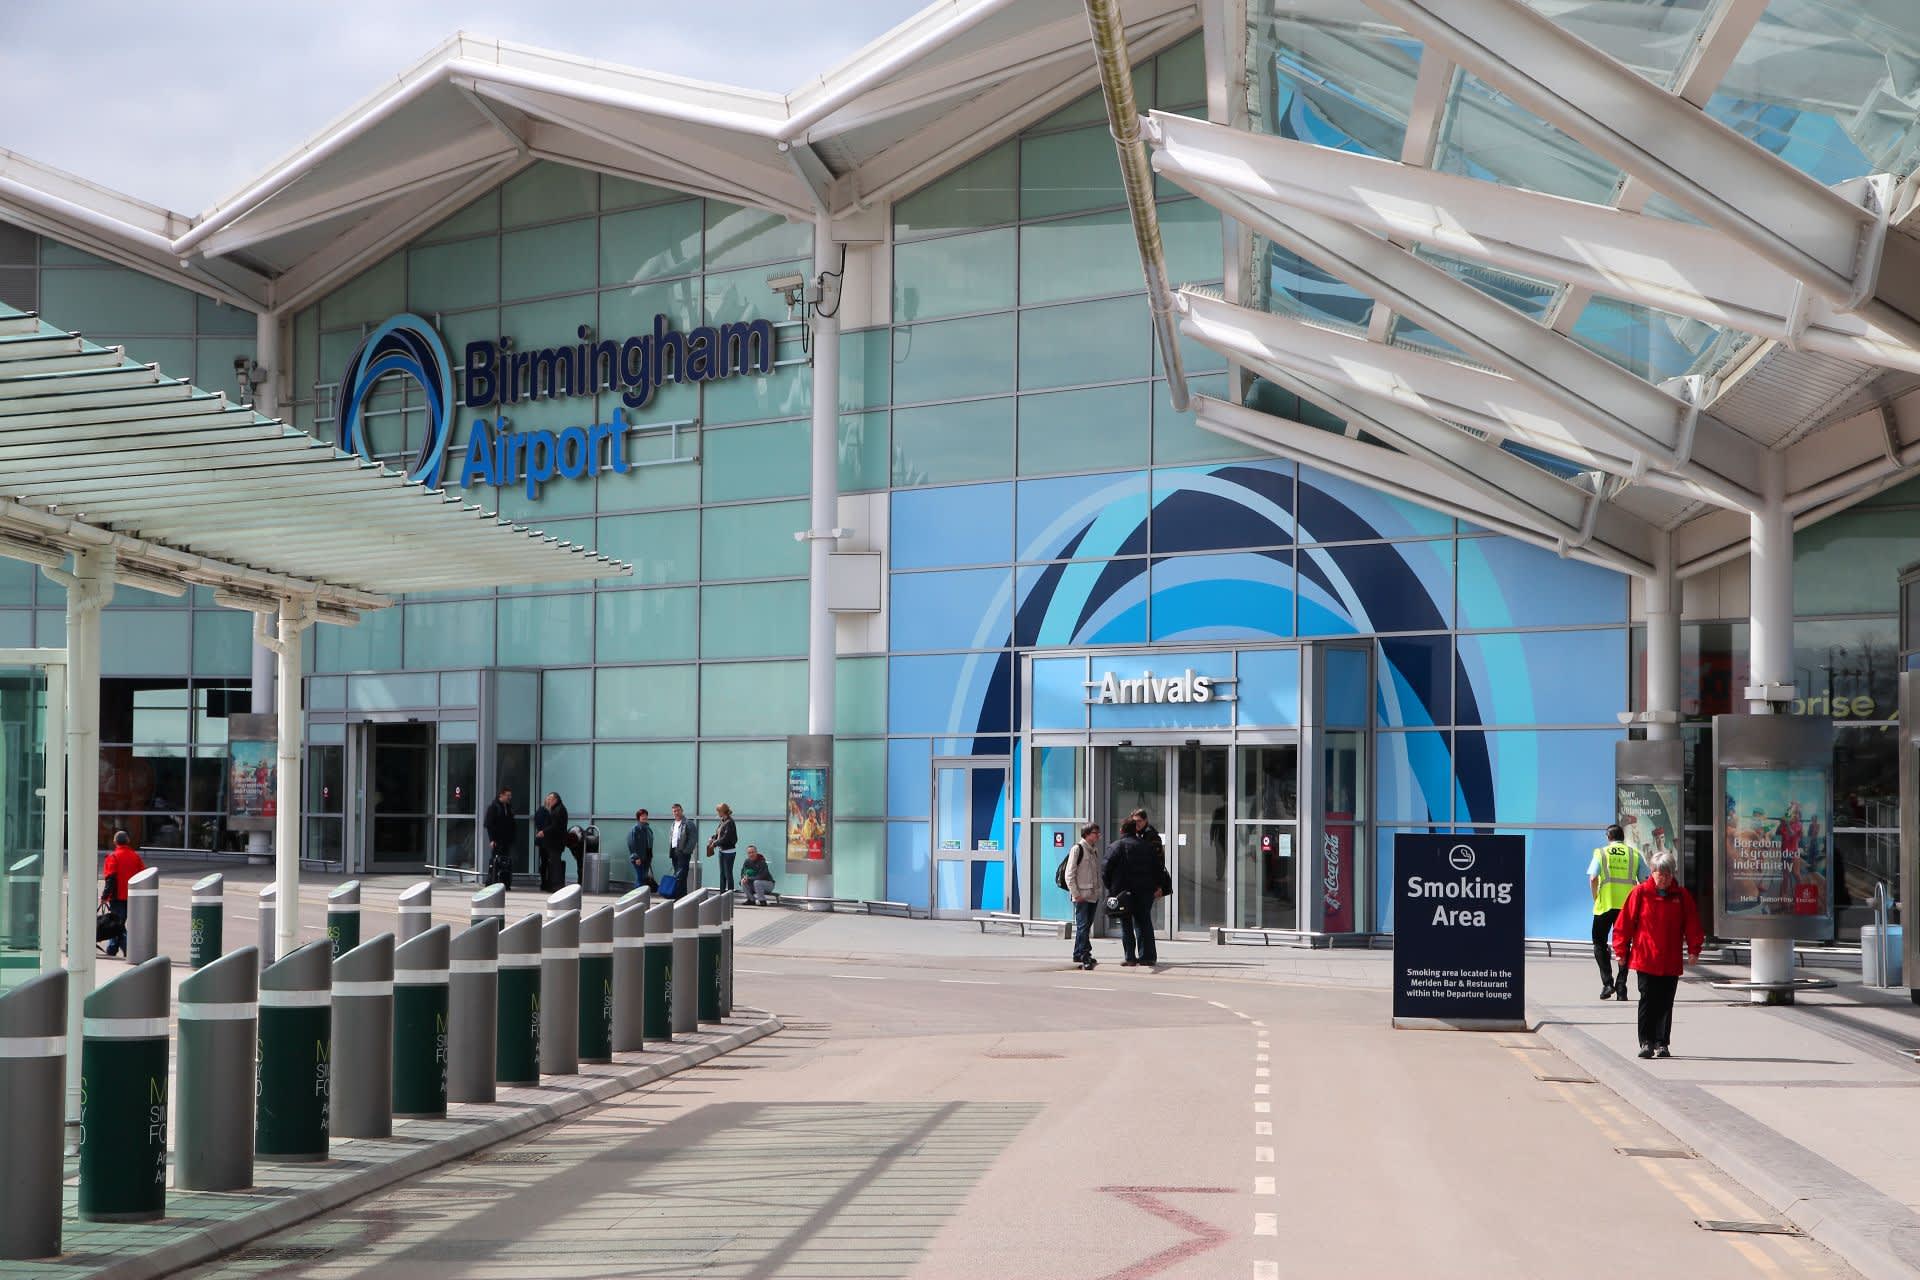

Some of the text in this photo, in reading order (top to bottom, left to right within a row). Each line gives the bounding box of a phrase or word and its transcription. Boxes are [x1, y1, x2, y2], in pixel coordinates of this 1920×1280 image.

[464, 313, 775, 409] Birmingham
[460, 407, 631, 500] Airport
[1100, 668, 1214, 704] Arrivals
[1734, 837, 1782, 848] Boredom
[1741, 847, 1801, 860] is grounded
[1733, 859, 1793, 873] indefinitely
[1407, 876, 1512, 904] Smoking
[1432, 905, 1486, 927] Area
[1407, 968, 1512, 978] Smoking area located in the
[1411, 979, 1442, 987] Meriden
[1444, 979, 1457, 987] Bar
[1466, 980, 1508, 988] Restaurant
[1446, 990, 1484, 999] Departure
[1485, 991, 1512, 999] lounge
